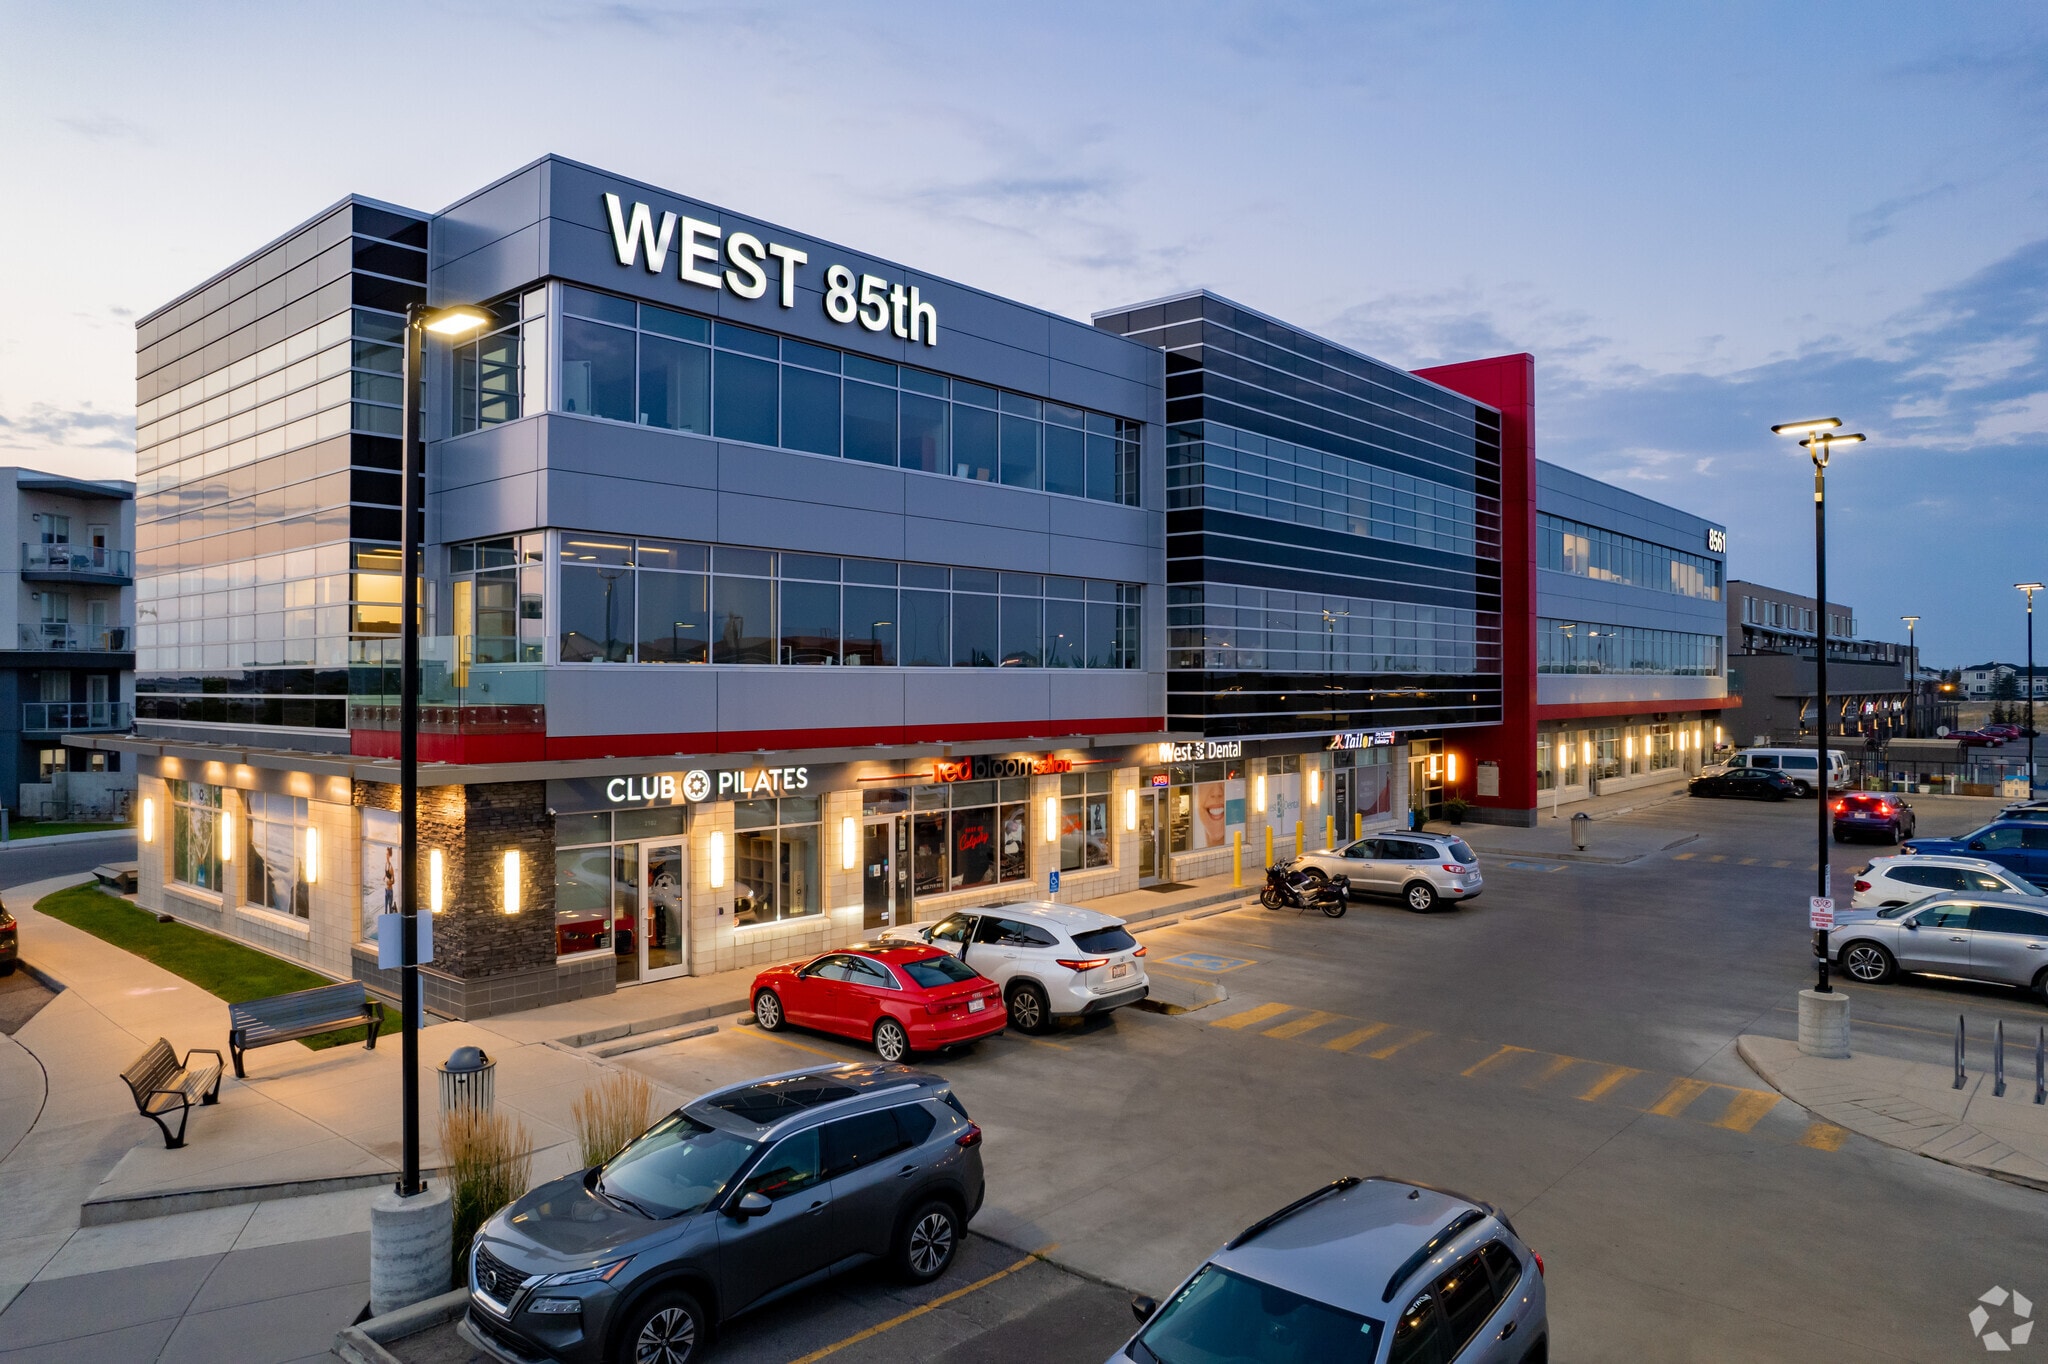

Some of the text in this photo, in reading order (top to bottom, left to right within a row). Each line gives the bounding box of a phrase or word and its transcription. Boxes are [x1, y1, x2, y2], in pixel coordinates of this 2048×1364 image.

[602, 192, 938, 347] WEST 85th
[1708, 528, 1726, 553] 8561
[1159, 741, 1241, 763] West Dental
[1344, 733, 1374, 749] Tailor
[607, 767, 808, 802] CLUB PILATES
[1153, 775, 1168, 784] OPEN
